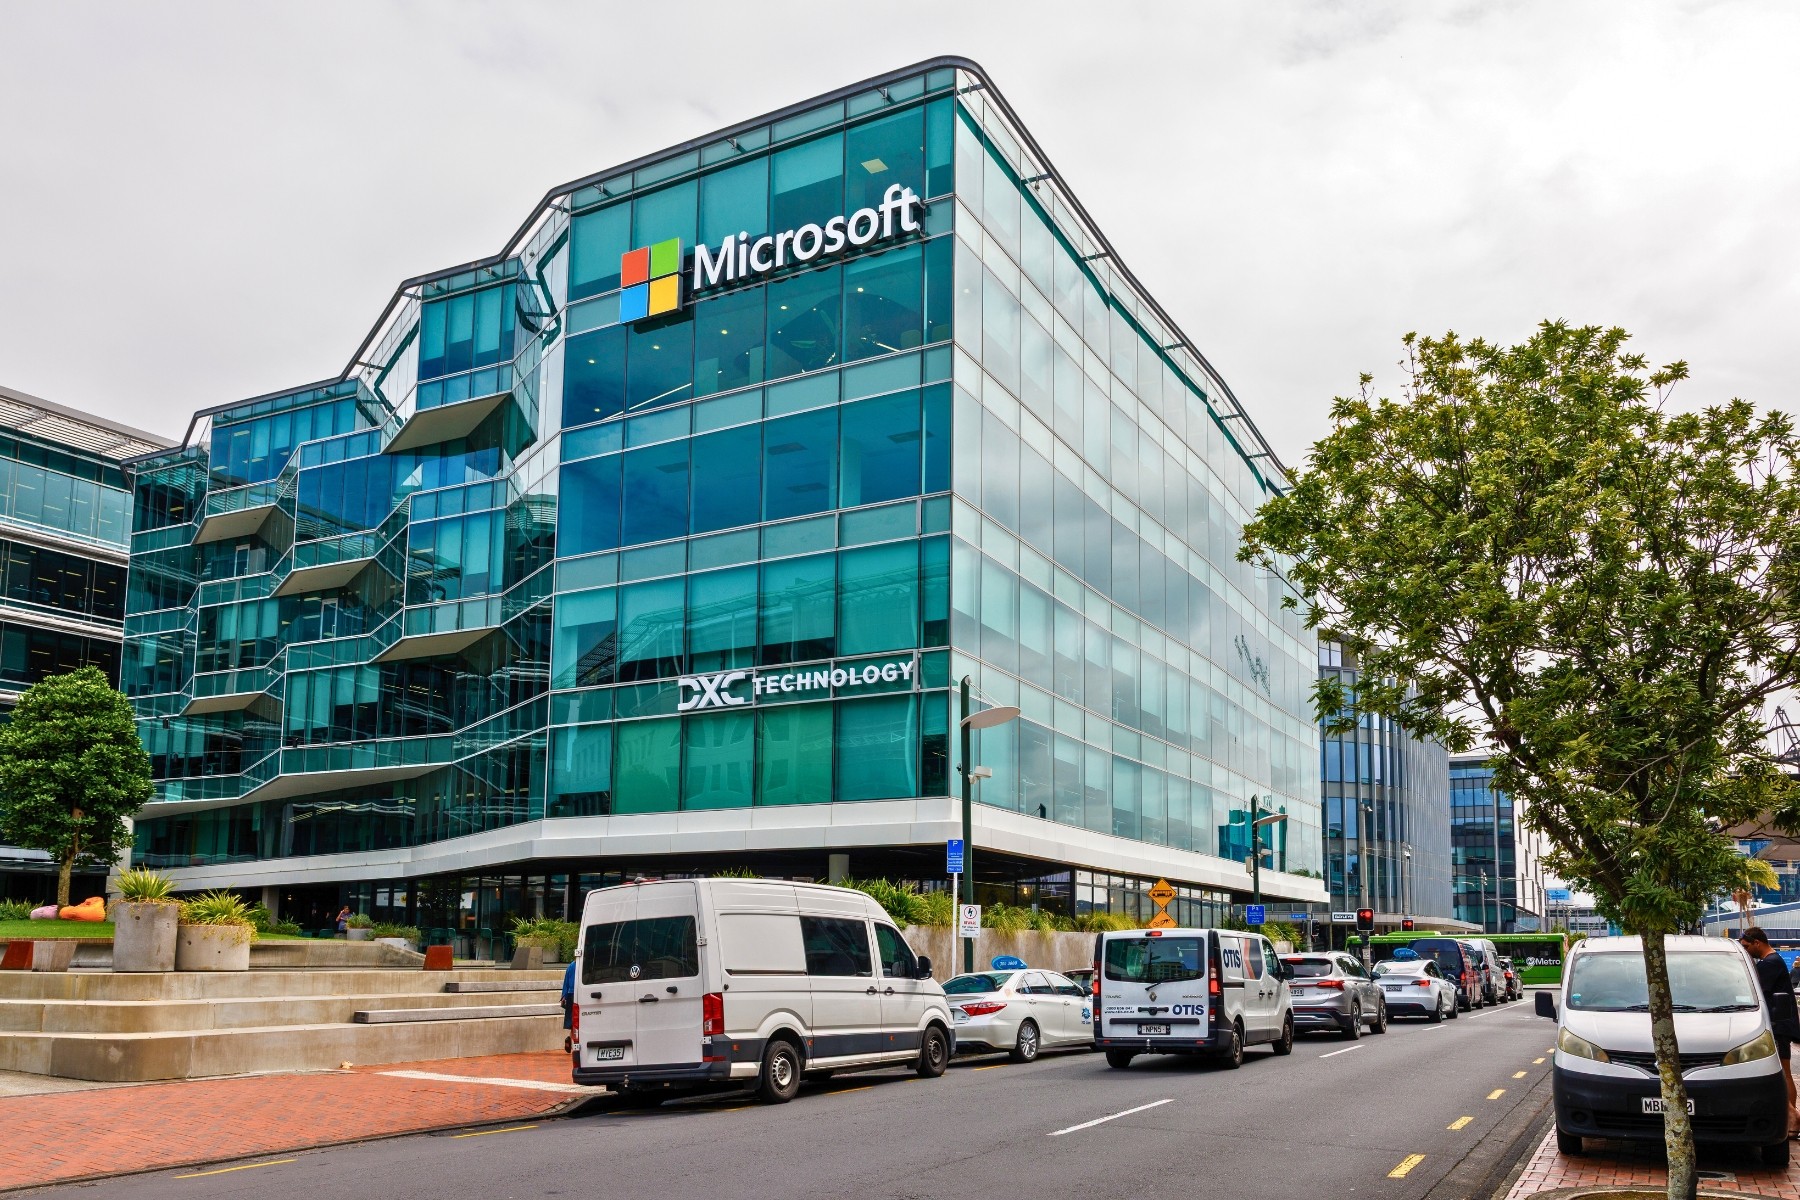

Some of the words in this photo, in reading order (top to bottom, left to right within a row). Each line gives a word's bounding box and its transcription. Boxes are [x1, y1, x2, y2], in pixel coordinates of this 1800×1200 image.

[693, 183, 922, 290] Microsoft
[677, 671, 746, 711] DXC
[752, 660, 914, 696] TECHNOLOGY
[1223, 948, 1242, 968] OTIS
[1535, 957, 1561, 965] Metro
[1172, 1004, 1205, 1016] OTIS
